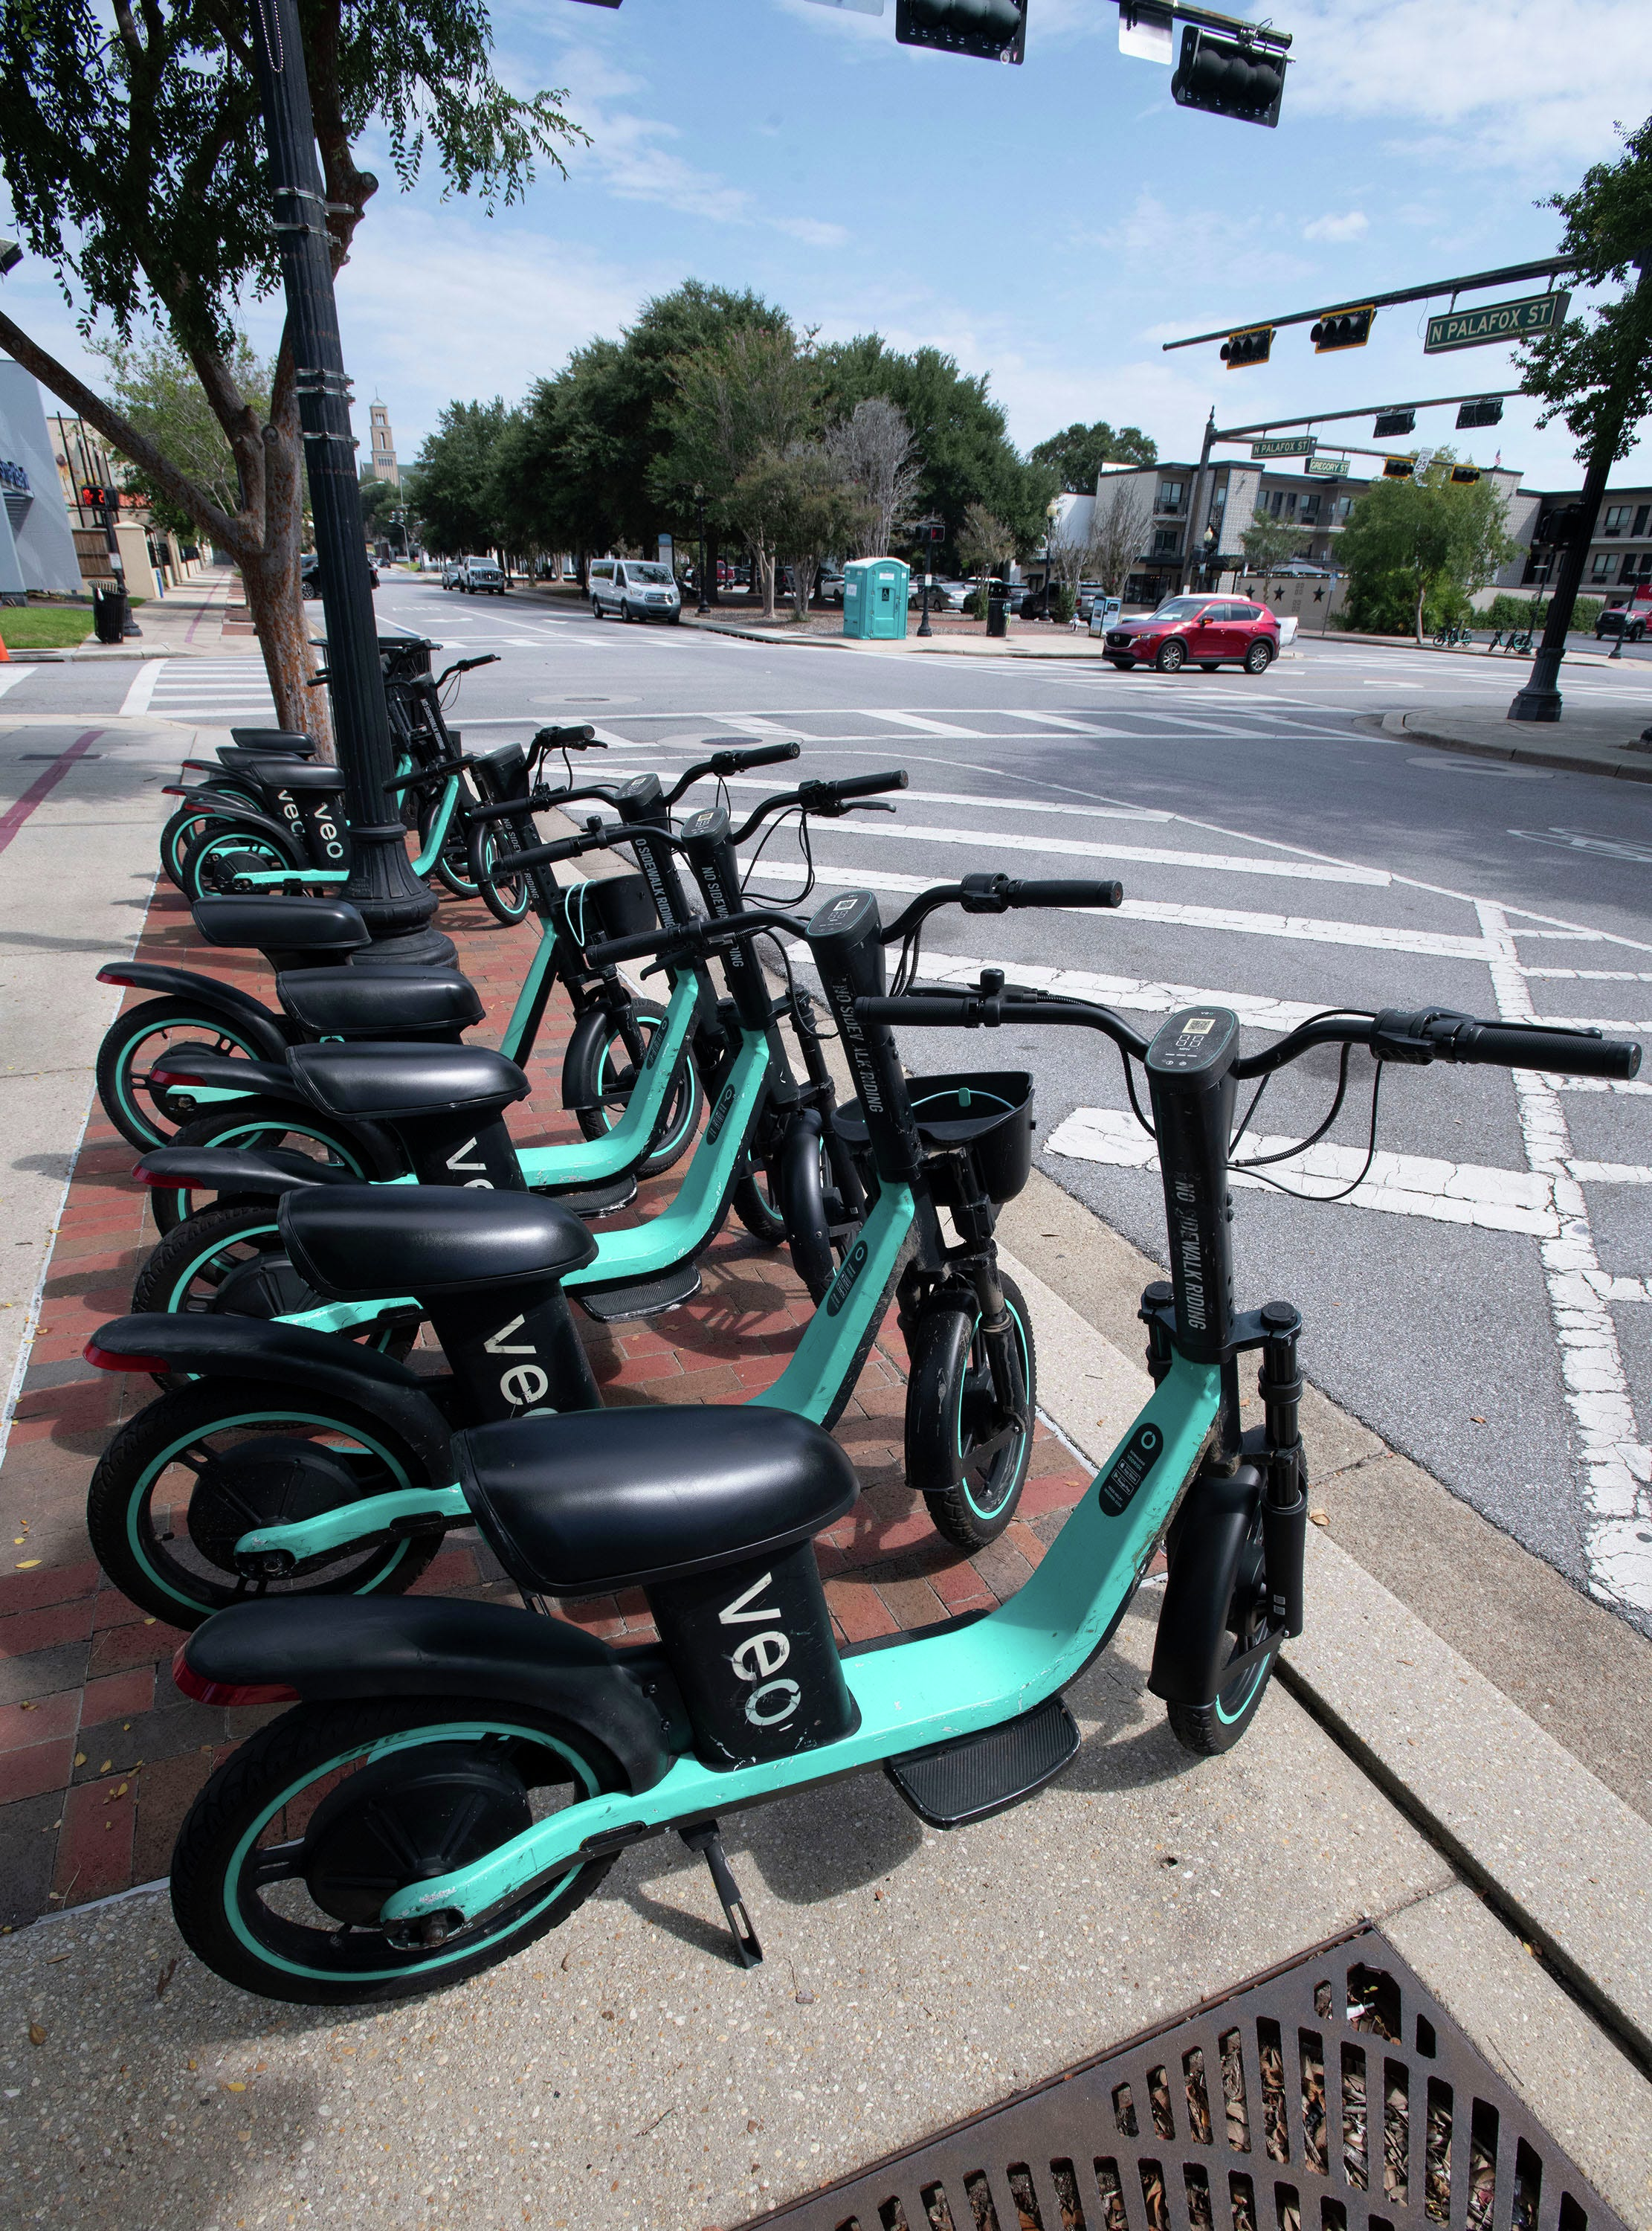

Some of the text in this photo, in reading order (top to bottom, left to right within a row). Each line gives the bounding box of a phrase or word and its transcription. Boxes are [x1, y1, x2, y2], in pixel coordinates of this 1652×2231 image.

[1431, 303, 1550, 342] N PALAFOX ST
[1253, 441, 1308, 454] N PALAFOX ST
[1416, 460, 1427, 470] 25
[1310, 461, 1349, 473] GREGORY ST
[423, 704, 439, 735] SIDEWALK
[314, 803, 343, 858] veo
[638, 846, 665, 896] SIDEWALK
[656, 896, 675, 929] RIDING
[702, 866, 716, 881] NO
[707, 883, 729, 919] SIDEWA
[833, 985, 851, 1003] NO
[860, 1071, 883, 1113] RIDING
[1175, 1181, 1196, 1203] NO
[1185, 1282, 1207, 1330] RIDING
[483, 1313, 559, 1417] ve
[718, 1571, 801, 1726] veo
